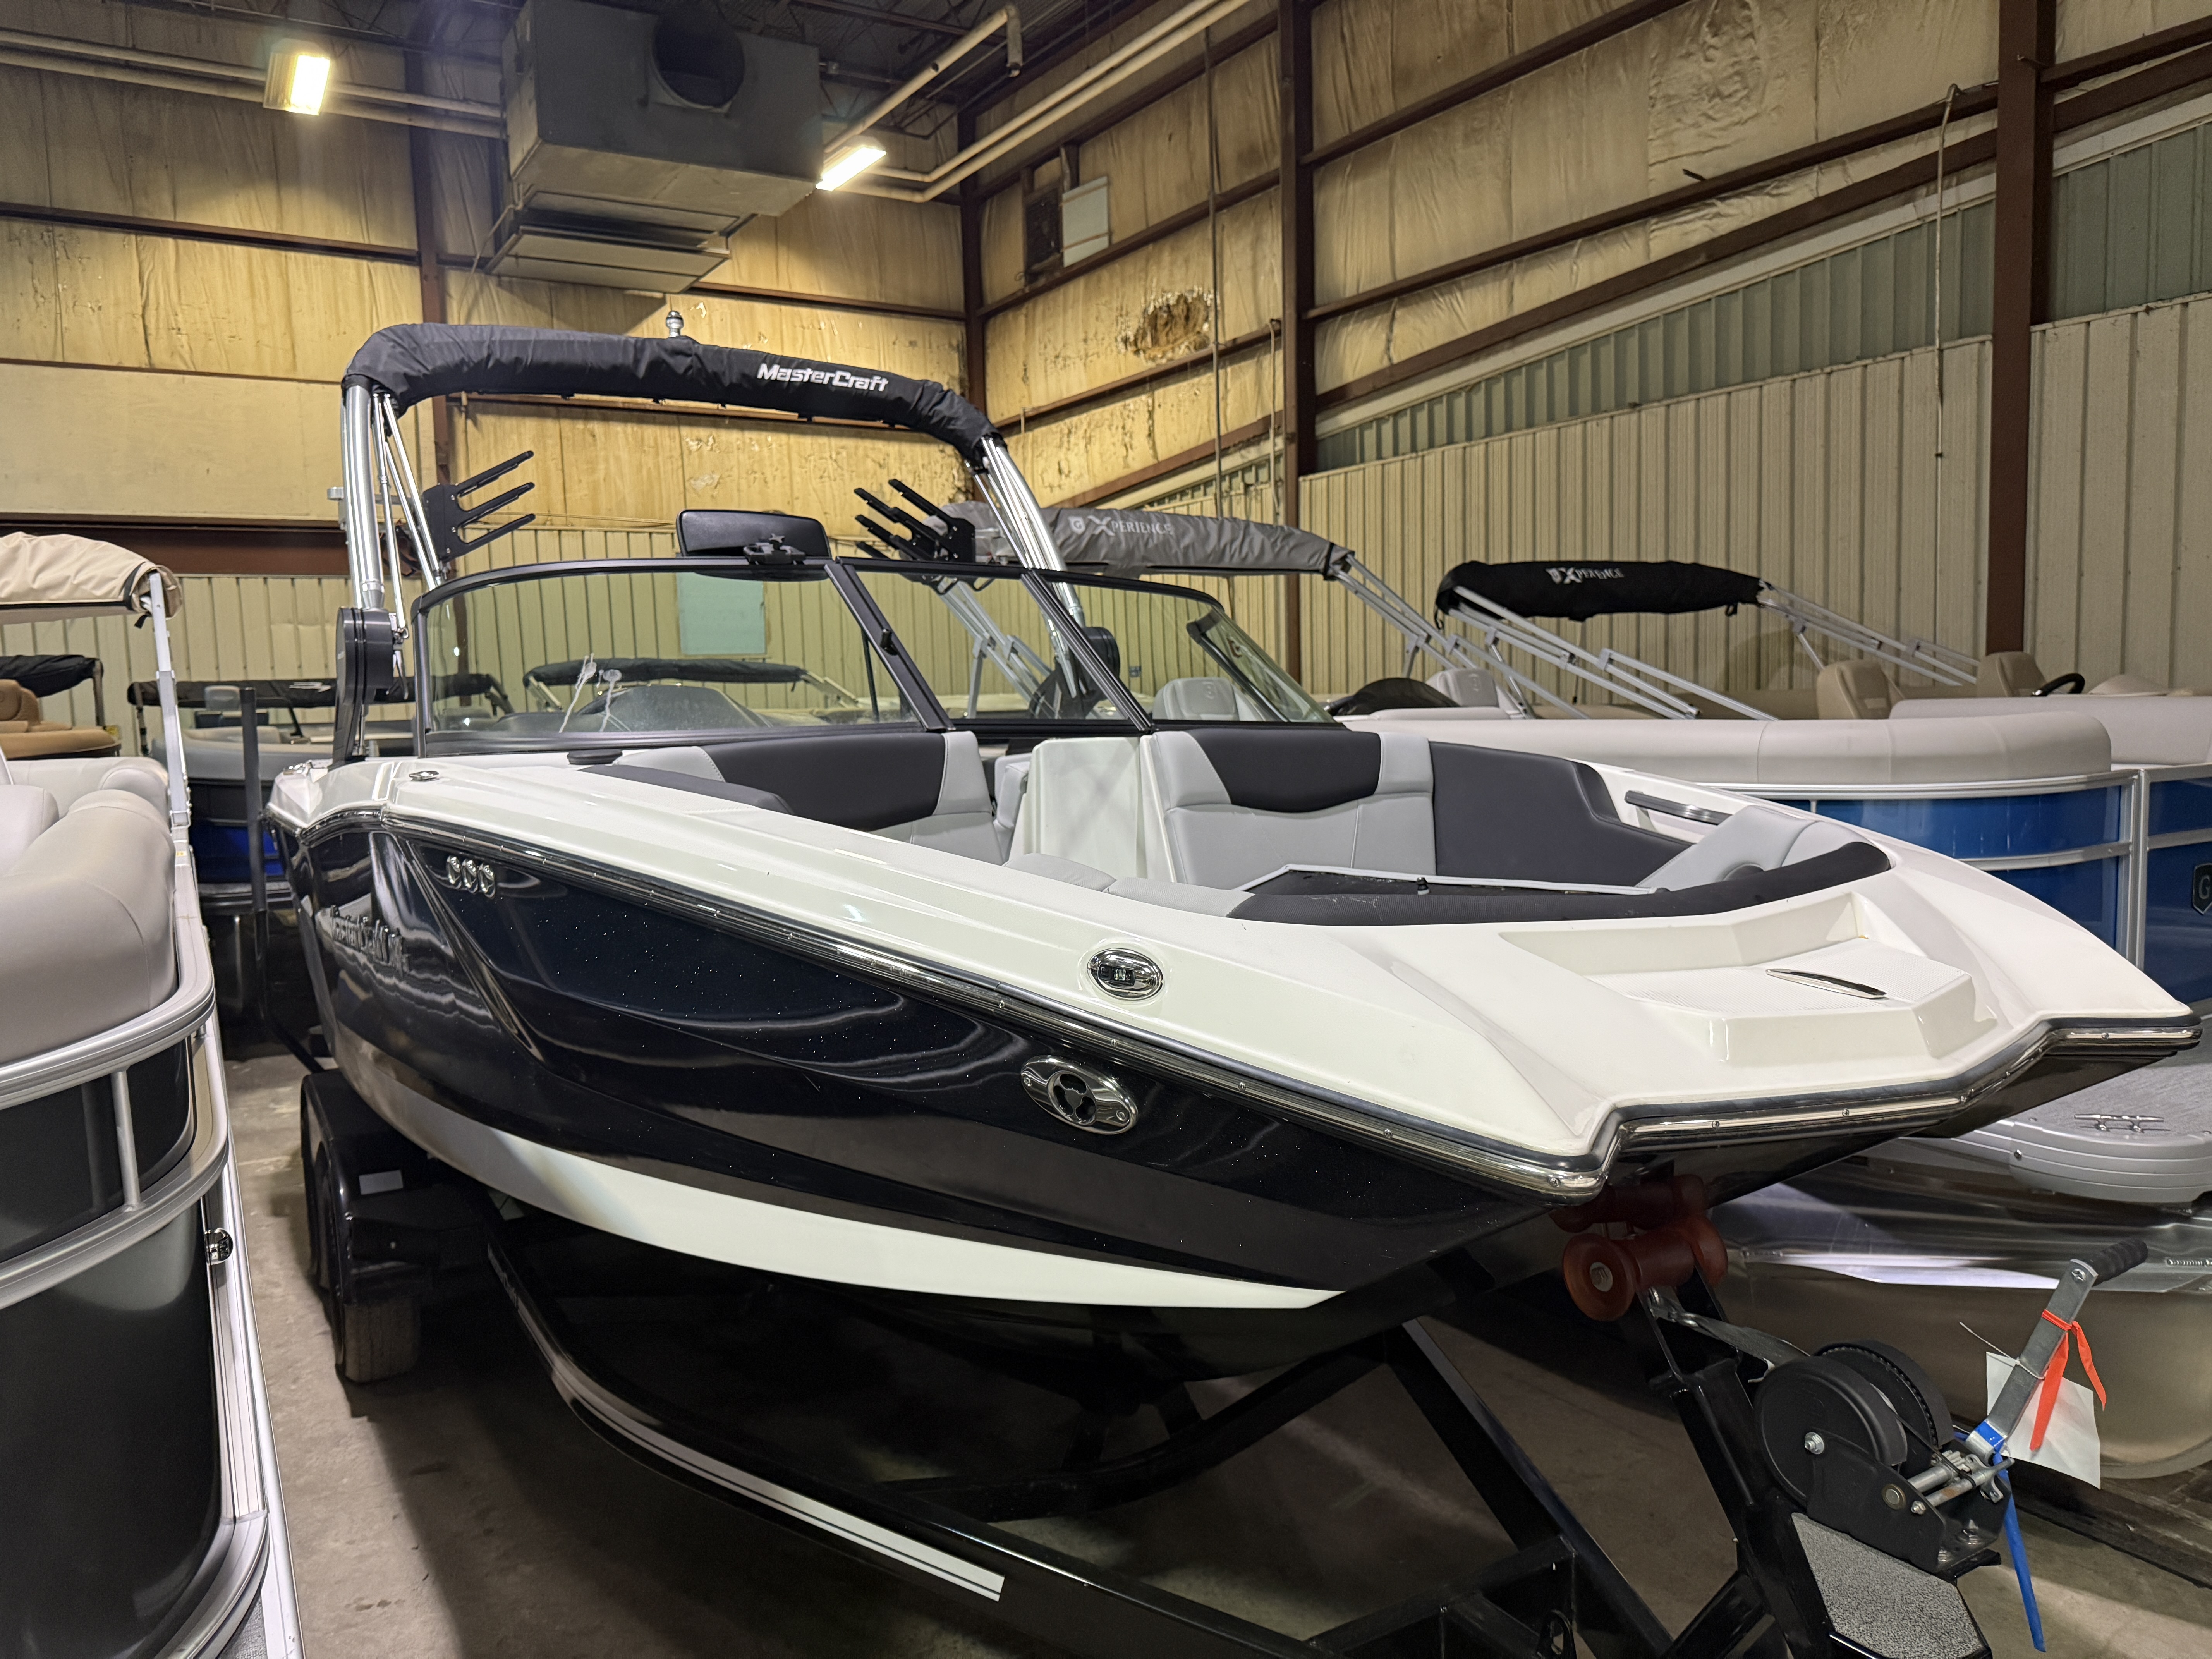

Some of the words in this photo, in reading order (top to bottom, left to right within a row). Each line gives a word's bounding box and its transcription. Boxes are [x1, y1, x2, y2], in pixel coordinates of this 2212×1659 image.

[757, 363, 889, 392] MasterCraft
[1558, 567, 1624, 584] XPERENCE
[2199, 875, 2210, 899] G
